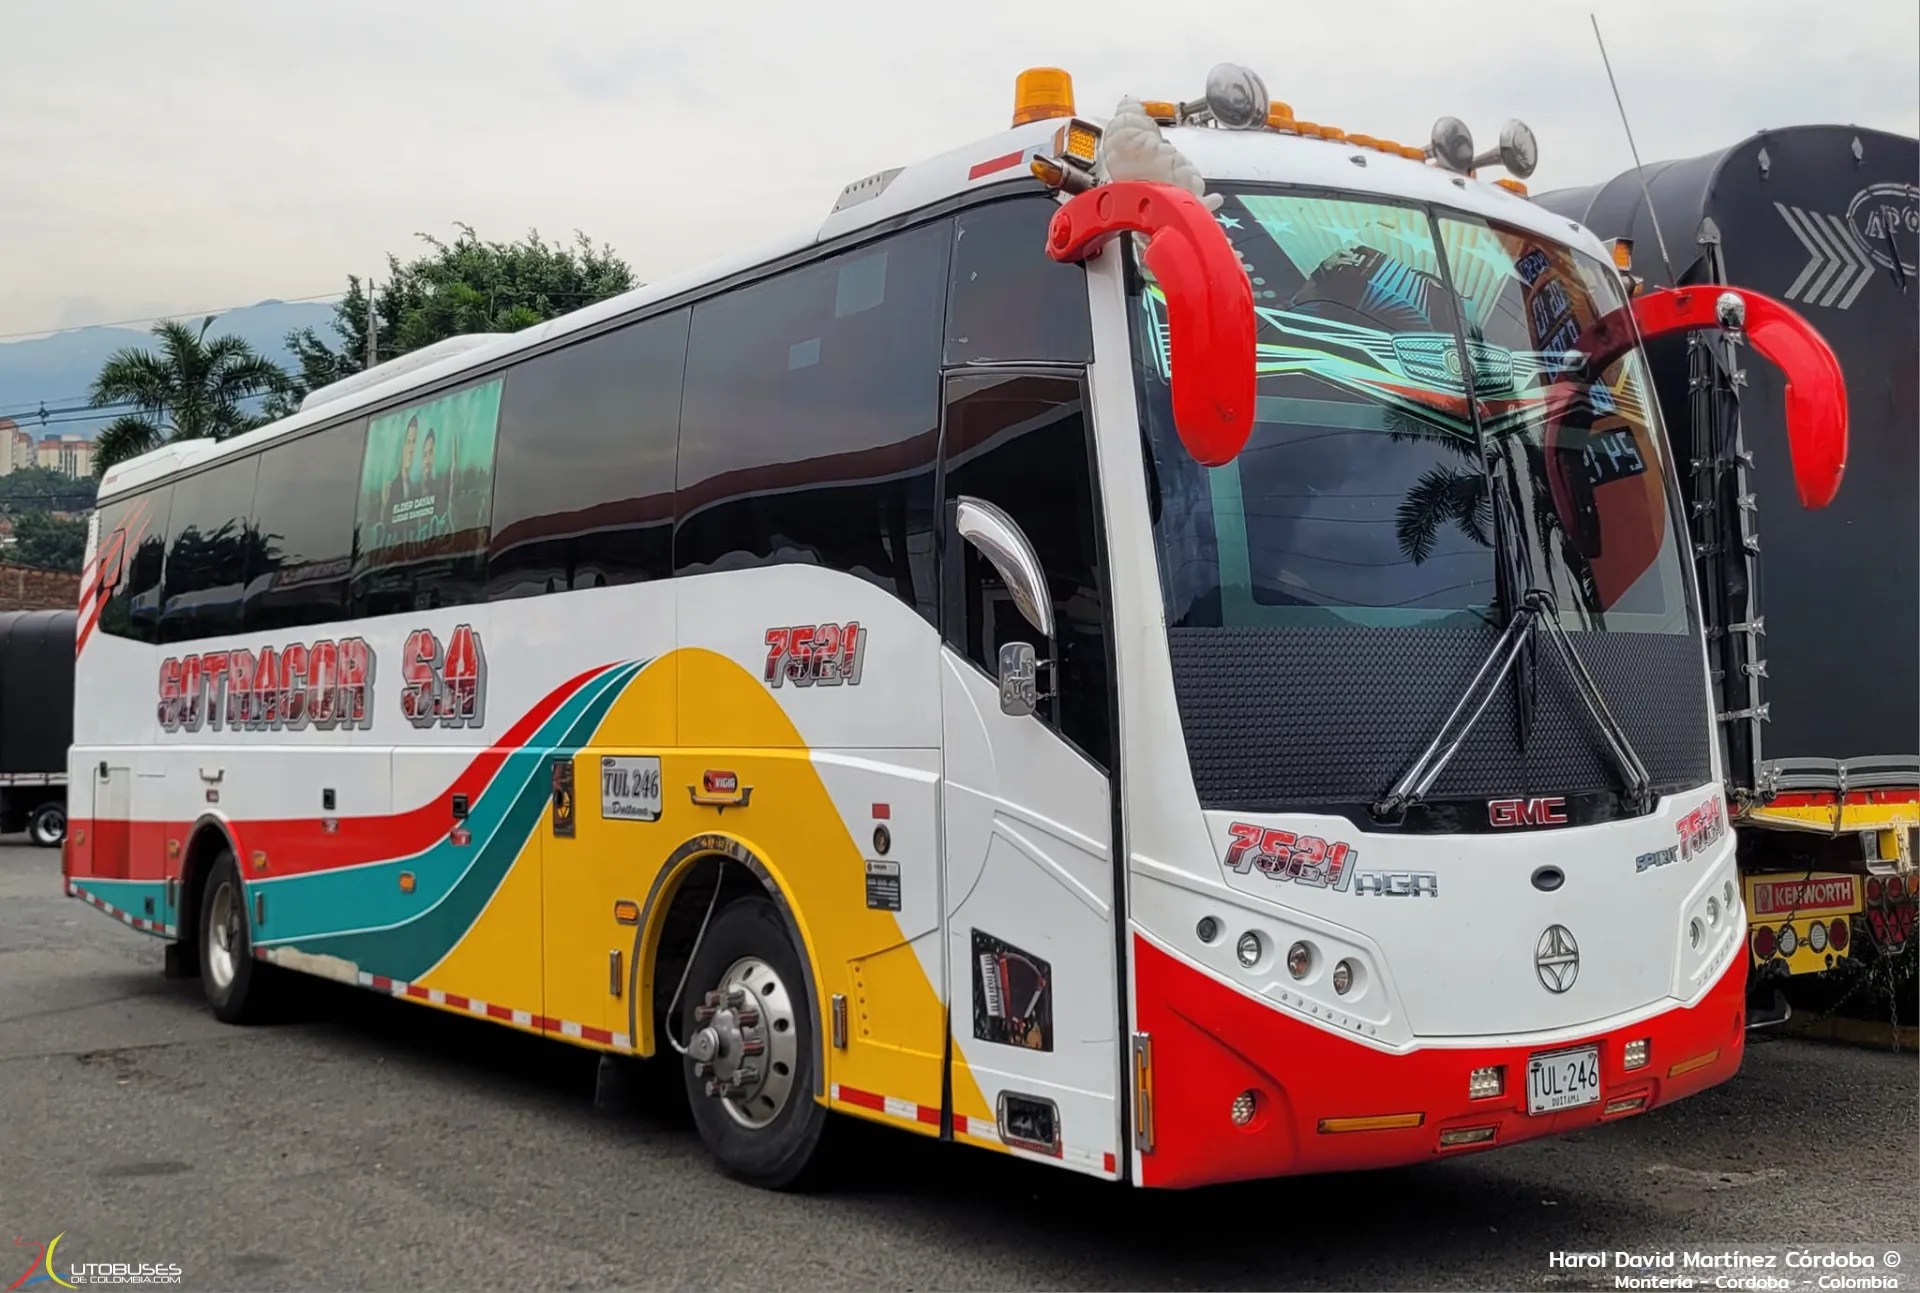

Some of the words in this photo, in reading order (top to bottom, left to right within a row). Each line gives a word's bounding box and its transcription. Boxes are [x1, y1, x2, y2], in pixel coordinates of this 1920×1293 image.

[157, 636, 376, 733] SOTRACOR
[764, 621, 867, 688] 7521
[603, 769, 629, 798] TUL
[632, 769, 659, 799] 246
[1488, 797, 1568, 828] GMC
[1224, 821, 1358, 892] 7521
[1635, 844, 1679, 873] SPIRIT
[1675, 794, 1724, 862] 7521
[1774, 881, 1851, 907] KENWORTH
